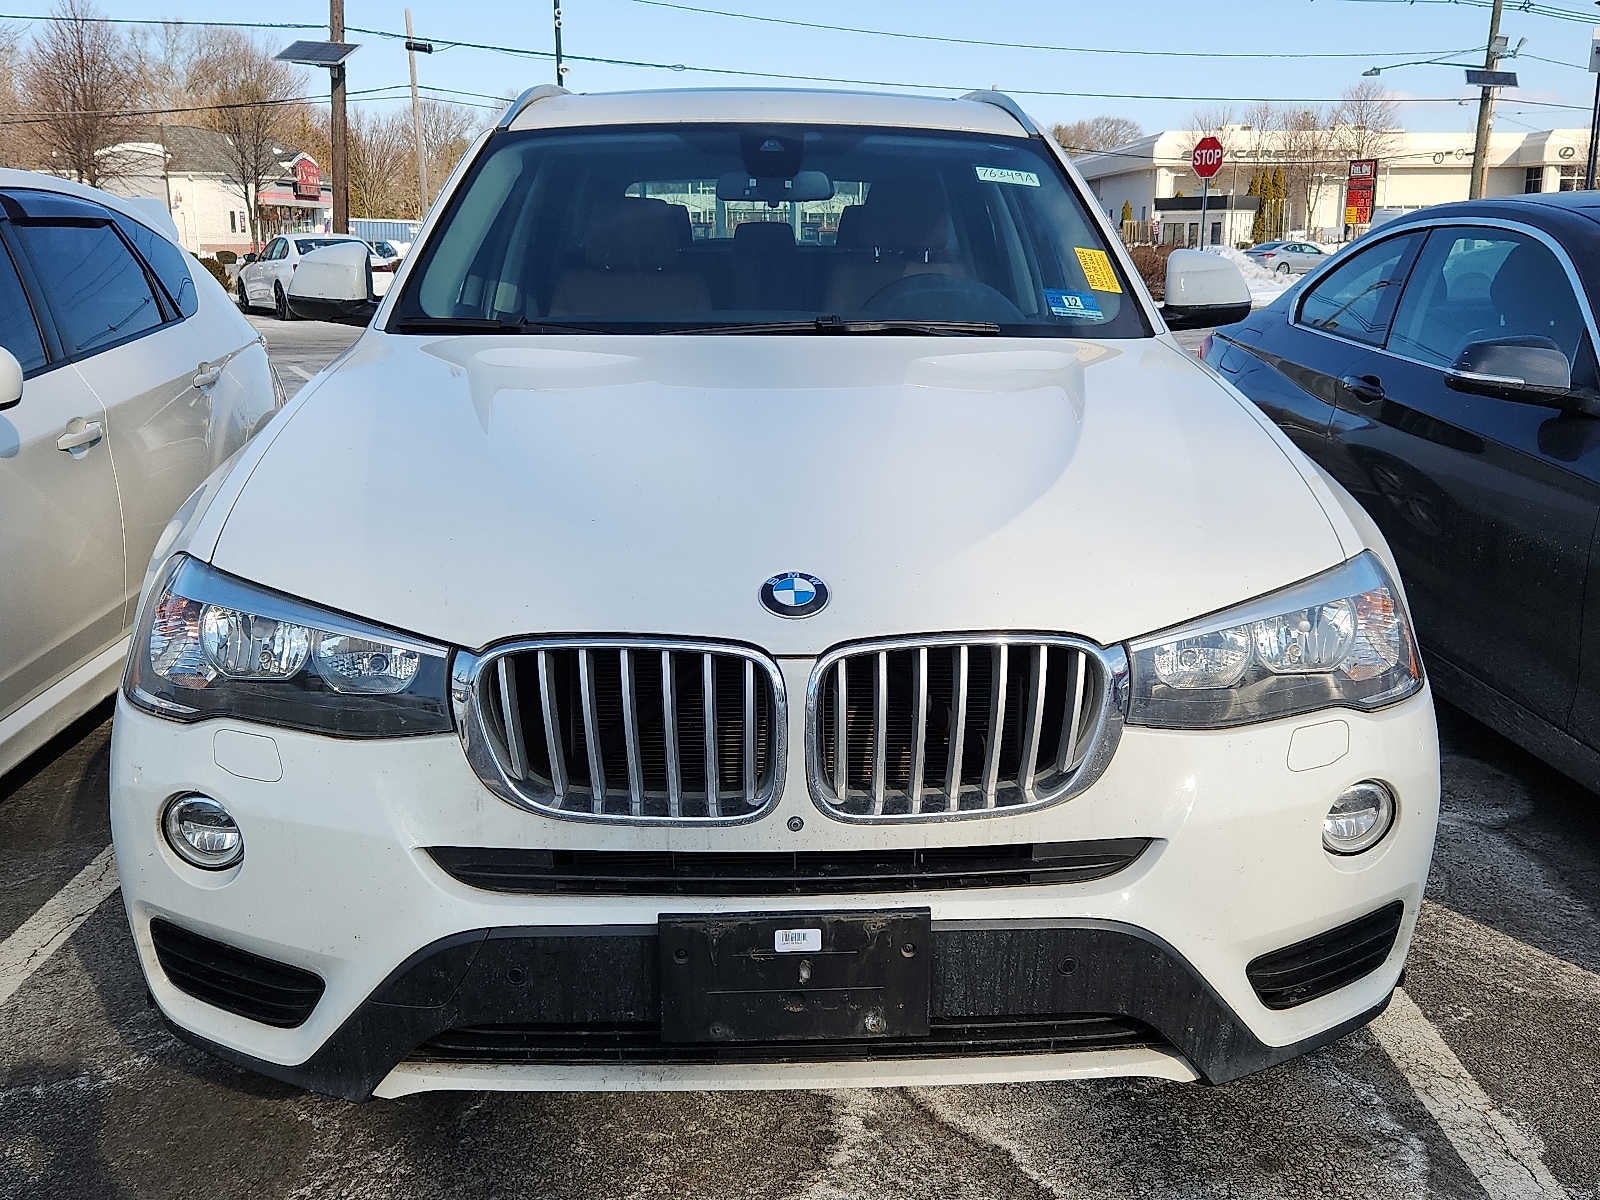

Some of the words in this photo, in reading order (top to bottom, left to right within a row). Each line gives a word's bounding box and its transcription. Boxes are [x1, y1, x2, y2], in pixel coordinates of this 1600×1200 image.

[1194, 149, 1221, 166] STOP
[1065, 296, 1079, 307] 12
[766, 572, 823, 585] BMW
